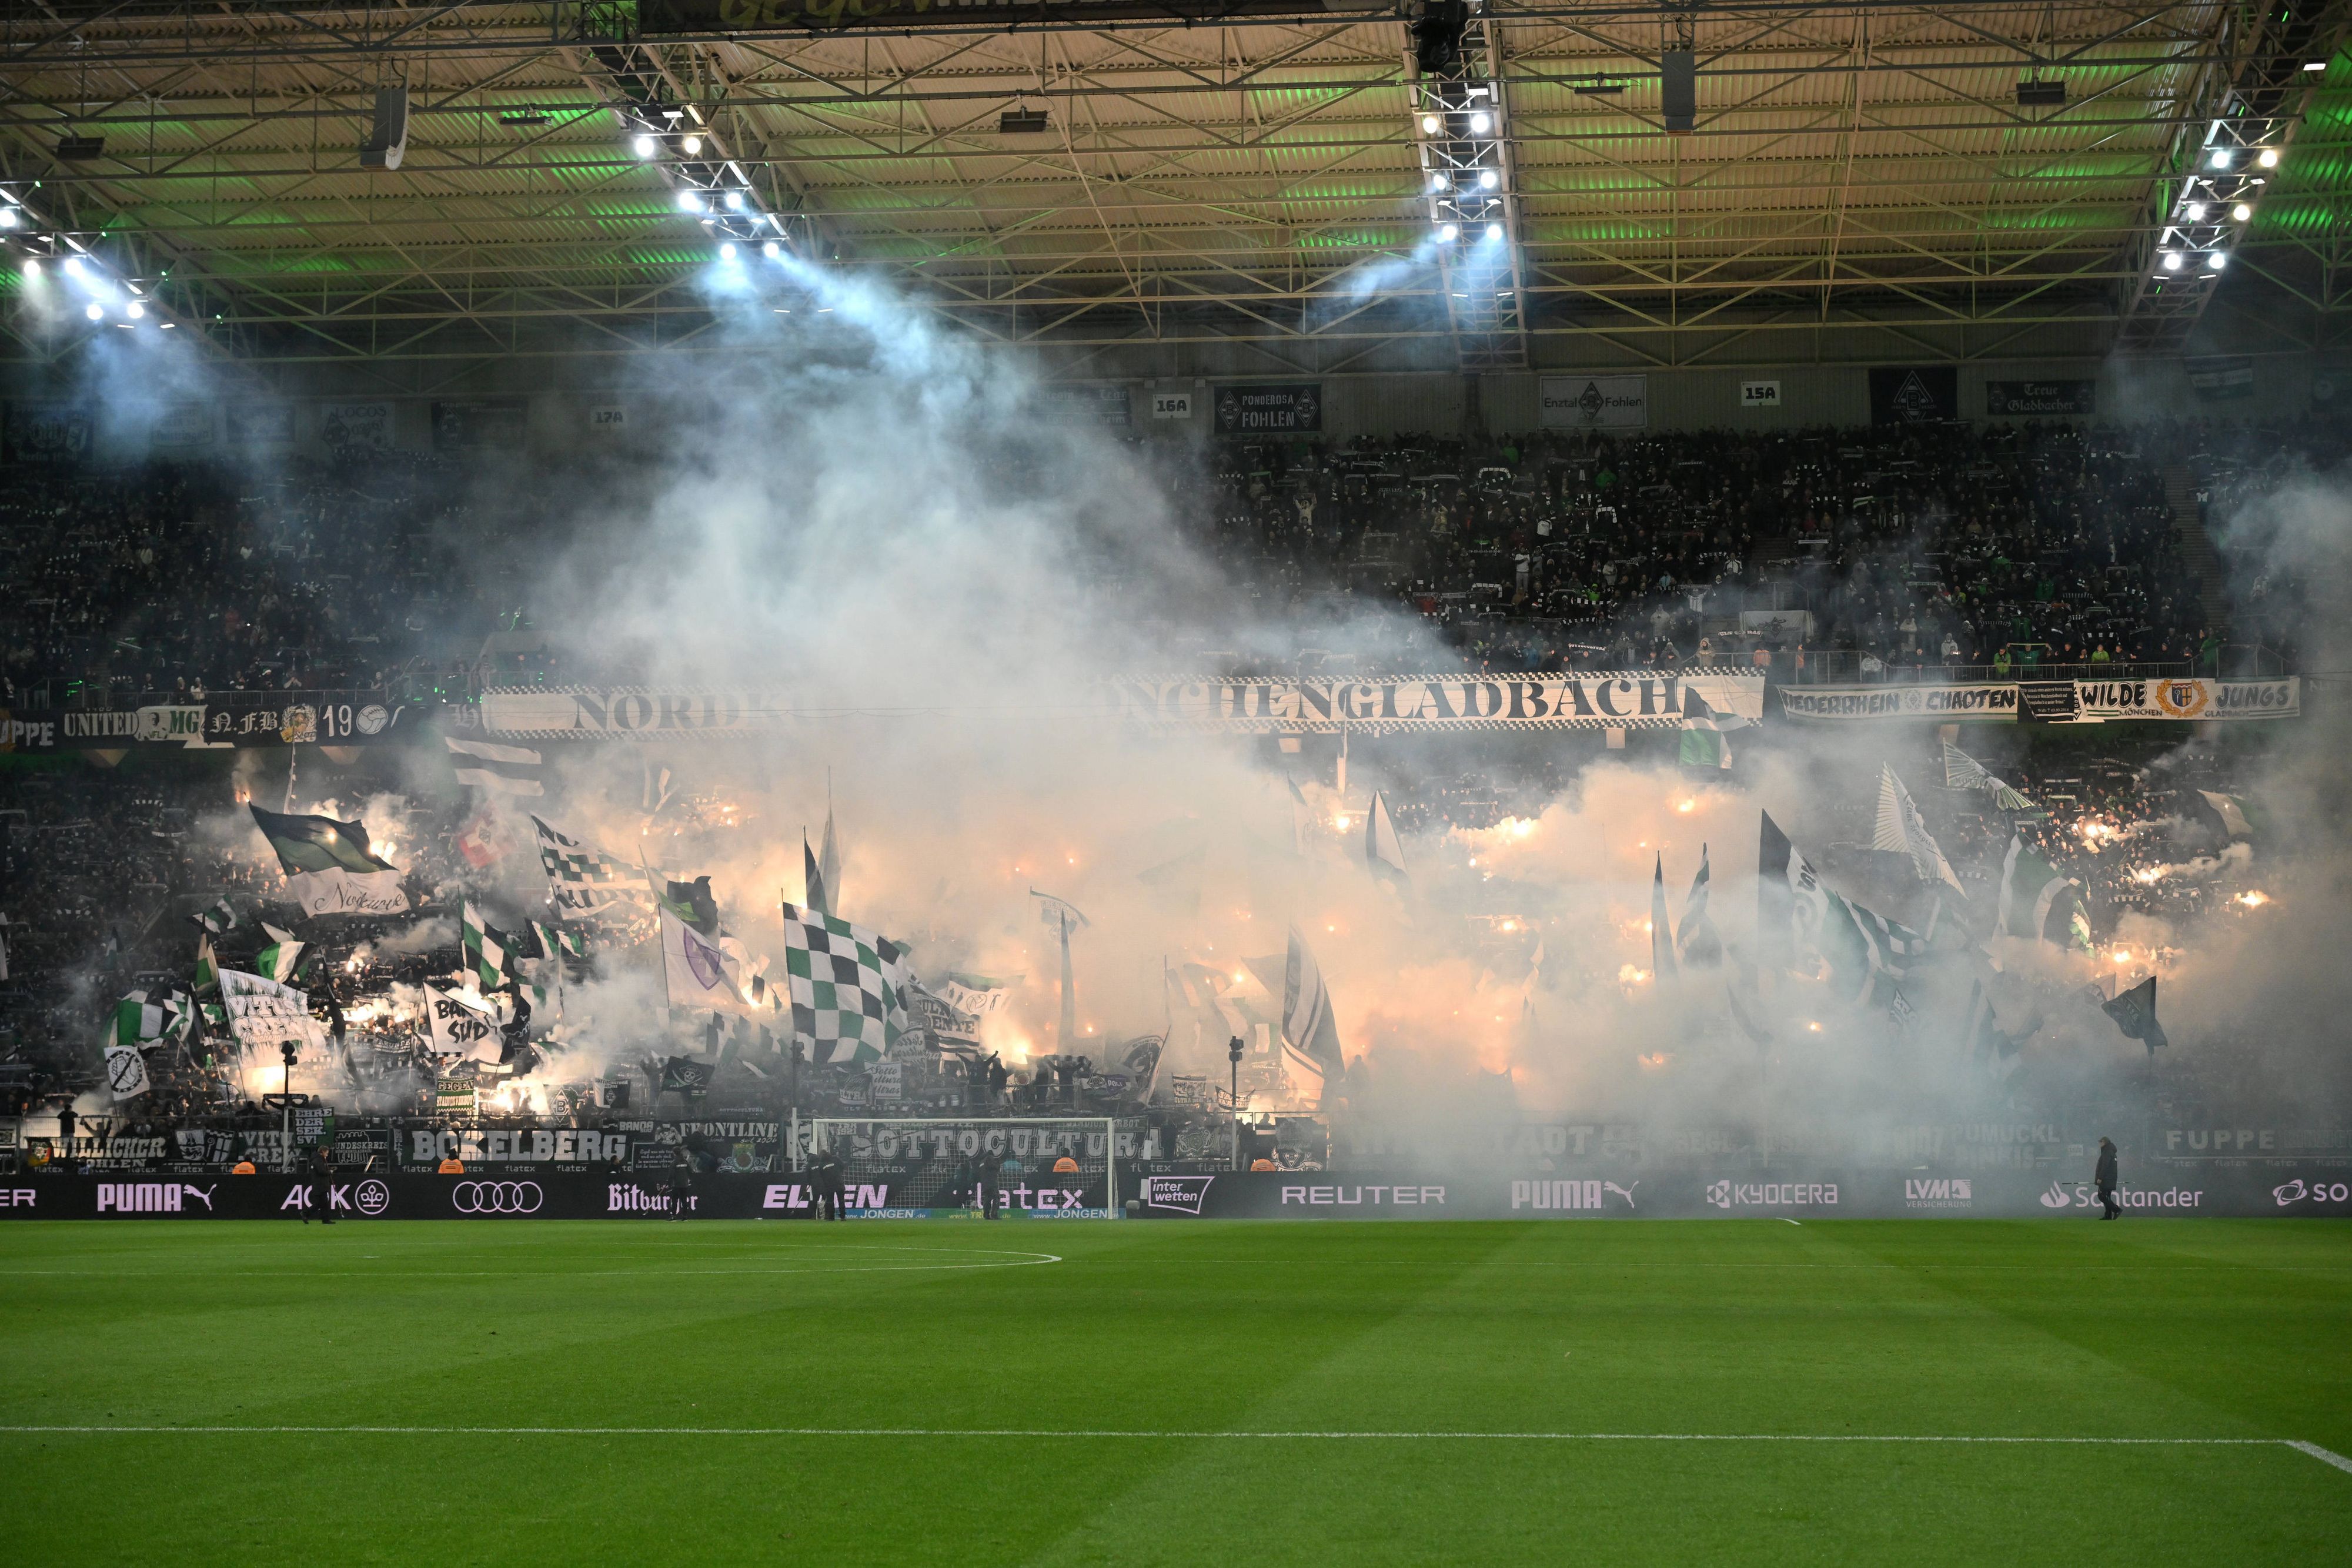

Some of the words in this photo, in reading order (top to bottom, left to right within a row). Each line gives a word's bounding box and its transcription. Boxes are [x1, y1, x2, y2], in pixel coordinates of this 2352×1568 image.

[1746, 387, 1775, 399] 15A
[2024, 383, 2058, 396] Treue
[1157, 399, 1187, 412] 16A
[1242, 394, 1294, 406] PONDEROSA
[1544, 397, 1577, 407] Enztal
[1605, 397, 1642, 407] Fohlen
[2007, 399, 2074, 412] Gladbacher
[596, 412, 623, 423] 17A
[1242, 411, 1294, 428] FOHLEN
[1108, 679, 1683, 720] NCHENGLADBACH
[1926, 689, 2017, 710] CHAOTEN
[2082, 681, 2147, 708] WILDE
[2215, 684, 2290, 709] JUNGS
[2119, 707, 2162, 717] MÖNCHEN
[64, 710, 139, 737] UNITED
[169, 710, 200, 734] MG
[228, 995, 300, 1017] VITUS
[447, 1019, 489, 1044] SUD
[437, 1081, 474, 1092] GEGEN
[295, 1108, 333, 1118] EHRE
[296, 1118, 324, 1126] DER
[619, 1121, 654, 1132] BANDA
[296, 1126, 326, 1135] SEK.
[244, 1131, 295, 1147] VITU
[297, 1135, 317, 1144] SV!
[851, 1126, 1164, 1159] SOTTOCULTURA
[2166, 1129, 2275, 1151] FUPPE
[51, 1136, 166, 1159] WILLICHER
[34, 1164, 64, 1173] flatex
[87, 1159, 147, 1168] OHLEN
[173, 1164, 203, 1173] flatex
[402, 1165, 433, 1173] flatex
[556, 1164, 587, 1172] flatex
[866, 1164, 907, 1174] flatex
[1131, 1162, 1172, 1173] fltex
[1152, 1179, 1183, 1192] inter
[1906, 1179, 1950, 1199] LVM
[97, 1183, 182, 1212] PUMA
[953, 1182, 1083, 1209] latex
[1154, 1189, 1198, 1202] wetten
[1282, 1186, 1446, 1204] REUTER
[1512, 1180, 1603, 1209] PUMA
[1735, 1183, 1838, 1204] KYOCERA
[2313, 1183, 2352, 1202] SO
[1906, 1200, 1972, 1208] VERSICHERUNG
